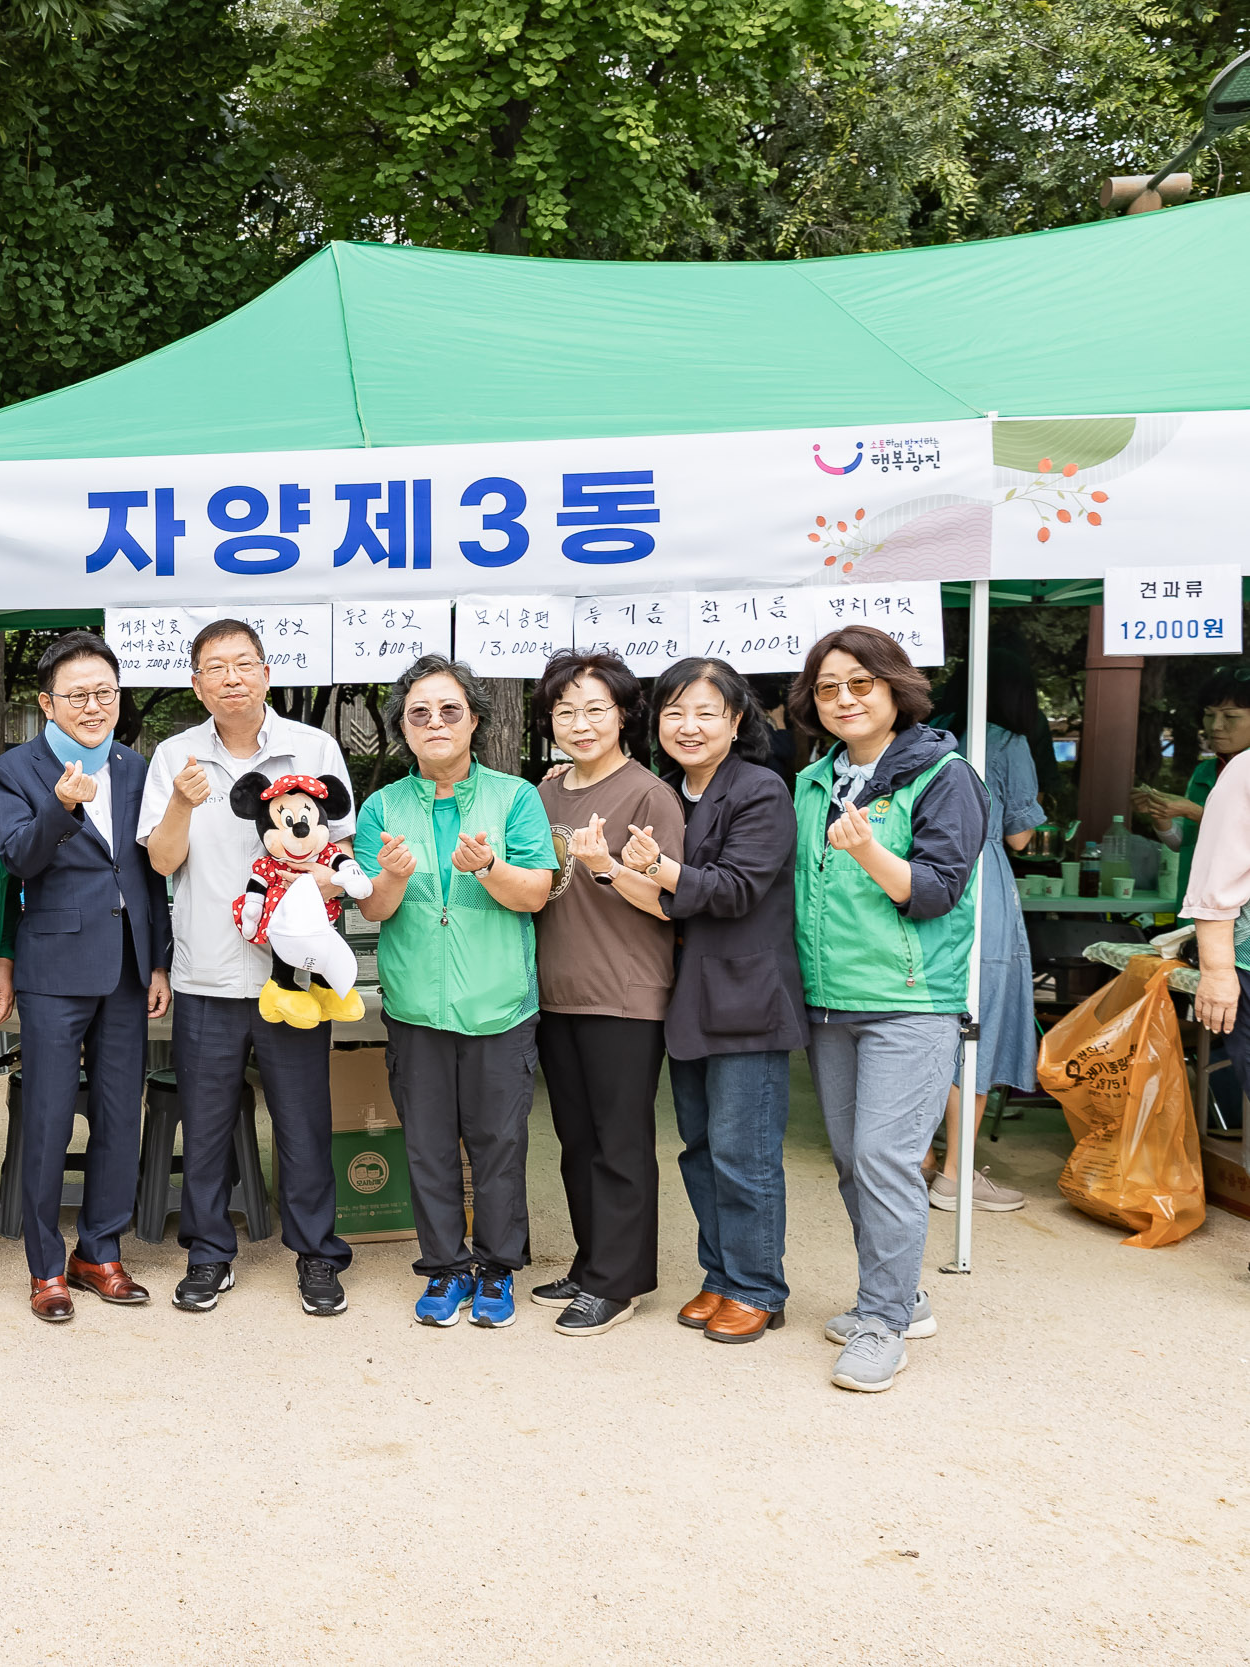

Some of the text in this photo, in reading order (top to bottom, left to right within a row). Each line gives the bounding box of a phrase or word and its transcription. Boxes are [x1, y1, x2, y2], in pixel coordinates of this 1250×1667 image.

[870, 450, 941, 473] 행복광진
[85, 469, 661, 577] 자양제3동
[1140, 580, 1203, 599] 견과류
[274, 617, 310, 637] 상보
[381, 608, 422, 630] 상보
[1120, 618, 1224, 641] 12,000원
[703, 635, 803, 656] 11,000원
